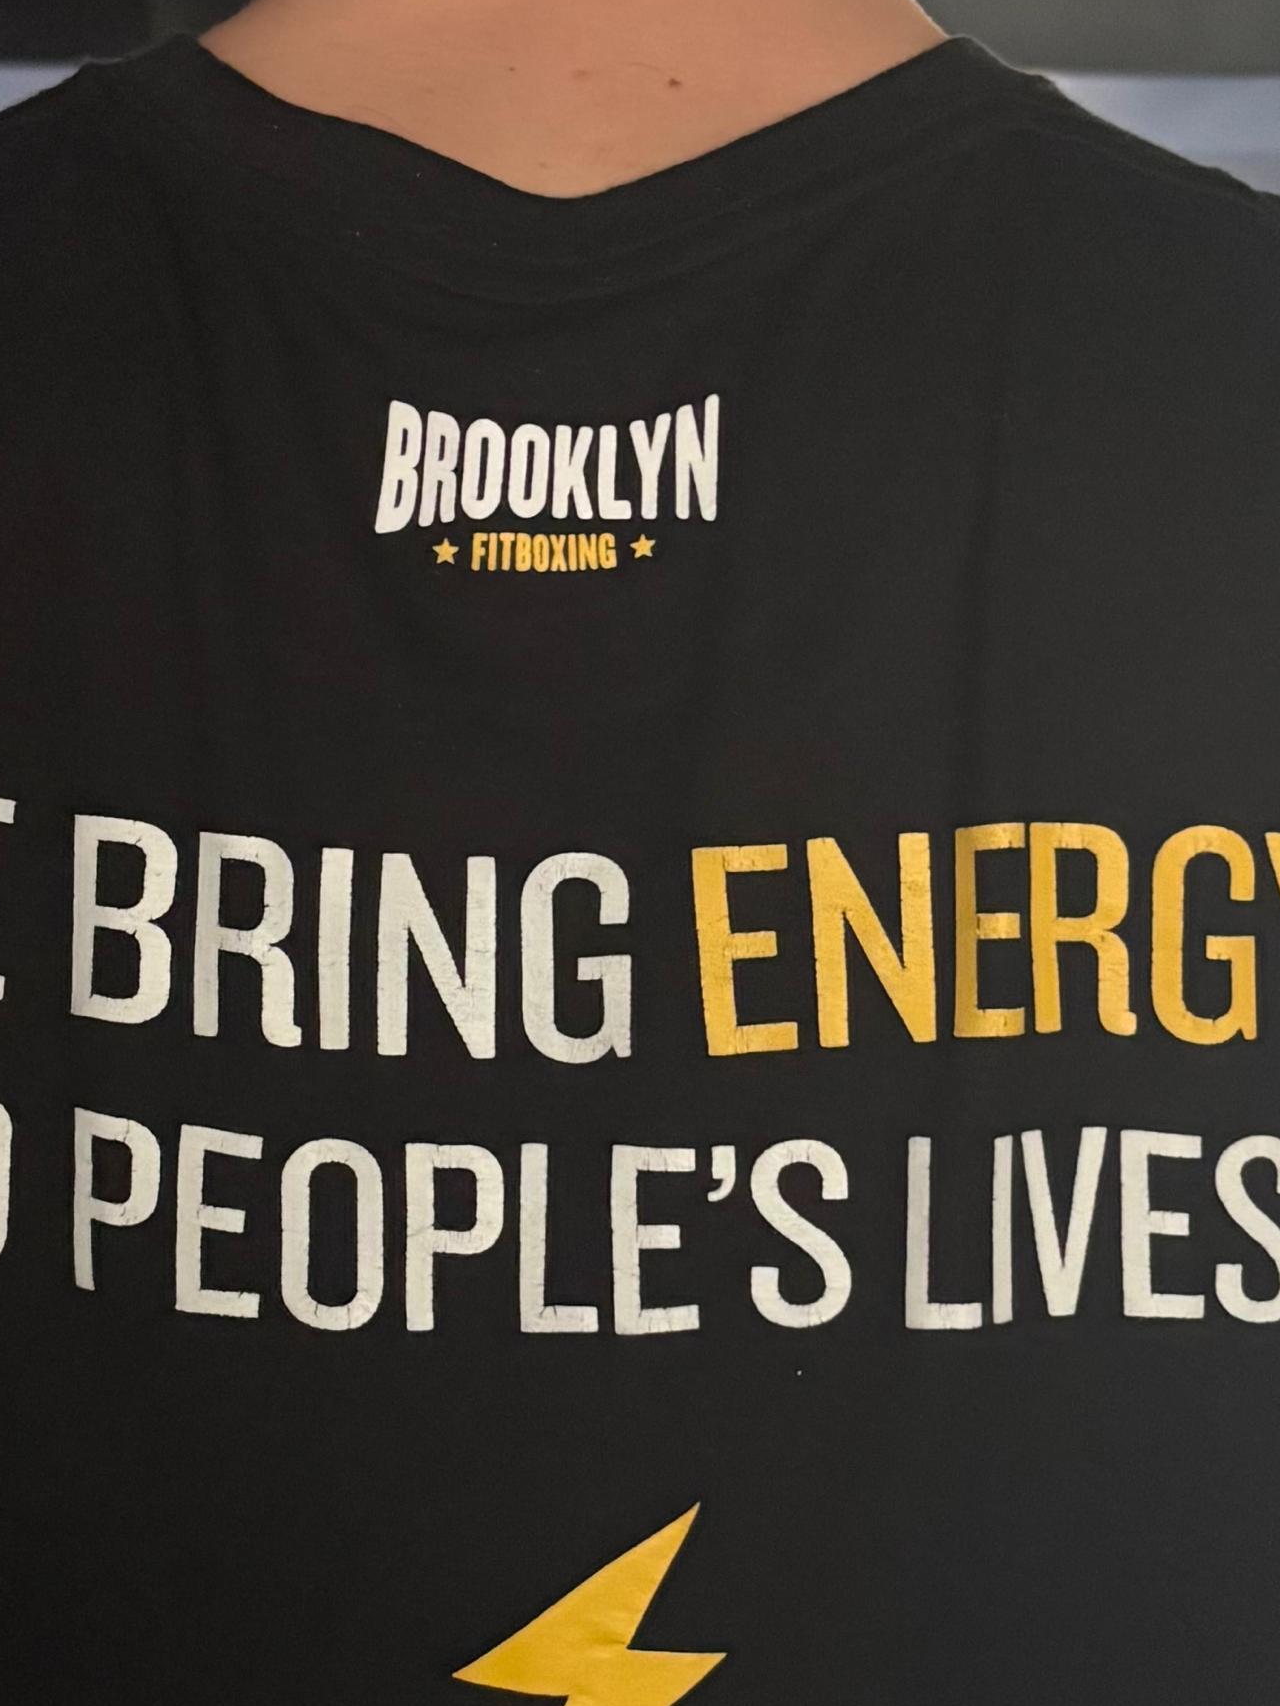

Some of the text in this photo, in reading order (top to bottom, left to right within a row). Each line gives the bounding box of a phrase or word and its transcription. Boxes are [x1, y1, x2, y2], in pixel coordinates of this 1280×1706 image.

[374, 393, 720, 534] BROOKLYN
[470, 532, 618, 572] FITBOXING
[70, 814, 632, 1064] BRING
[73, 1107, 852, 1336] PEOPLE'S
